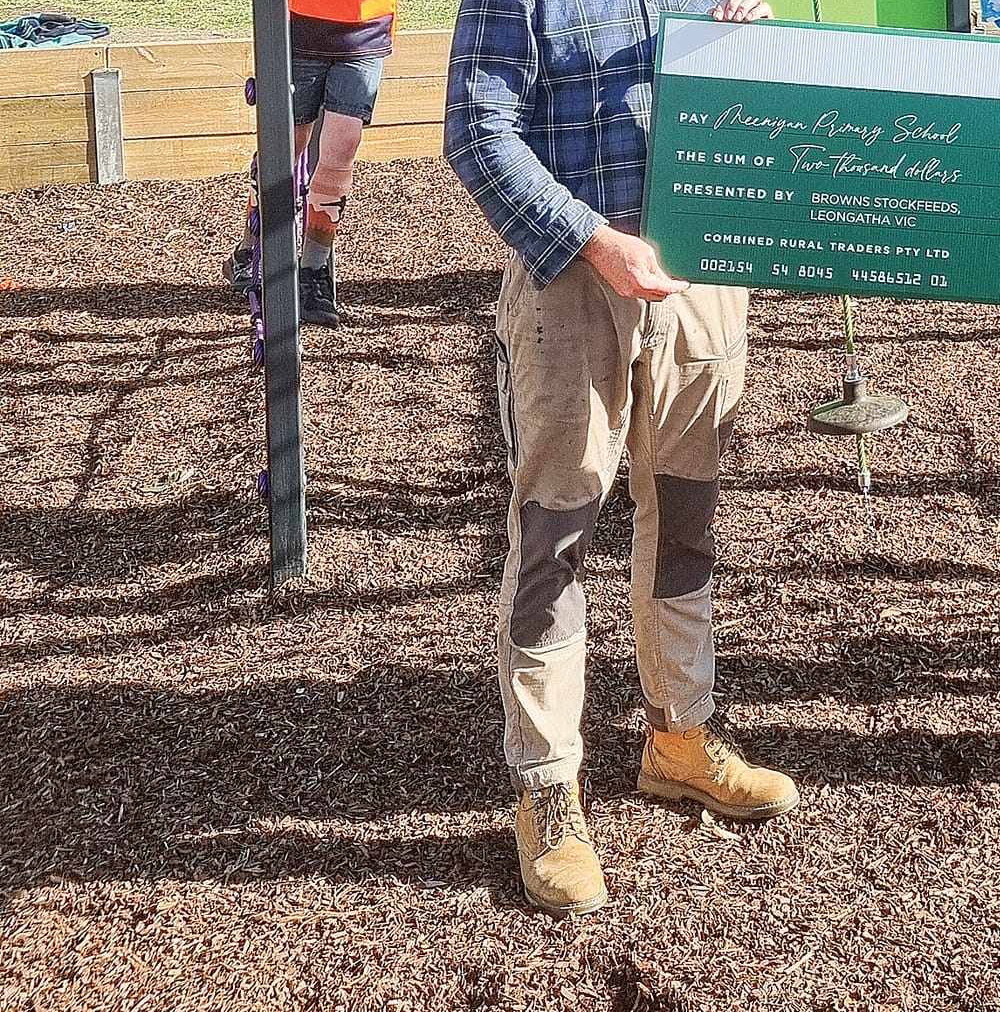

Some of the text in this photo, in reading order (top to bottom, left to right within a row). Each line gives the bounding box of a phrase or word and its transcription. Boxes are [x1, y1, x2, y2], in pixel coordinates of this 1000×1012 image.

[679, 103, 962, 146] PAY Meeniyan Primary School
[676, 144, 963, 184] THE SUM OF Two thousand dollars
[673, 182, 961, 215] PRESENTED BY BROWNS STOCKFEEDS,
[810, 209, 917, 227] LEONGATHA VIC
[703, 233, 950, 259] COMBINED RURAL TRADERS PTY LTD
[700, 258, 947, 287] 002154 54 8045 44586512 01
